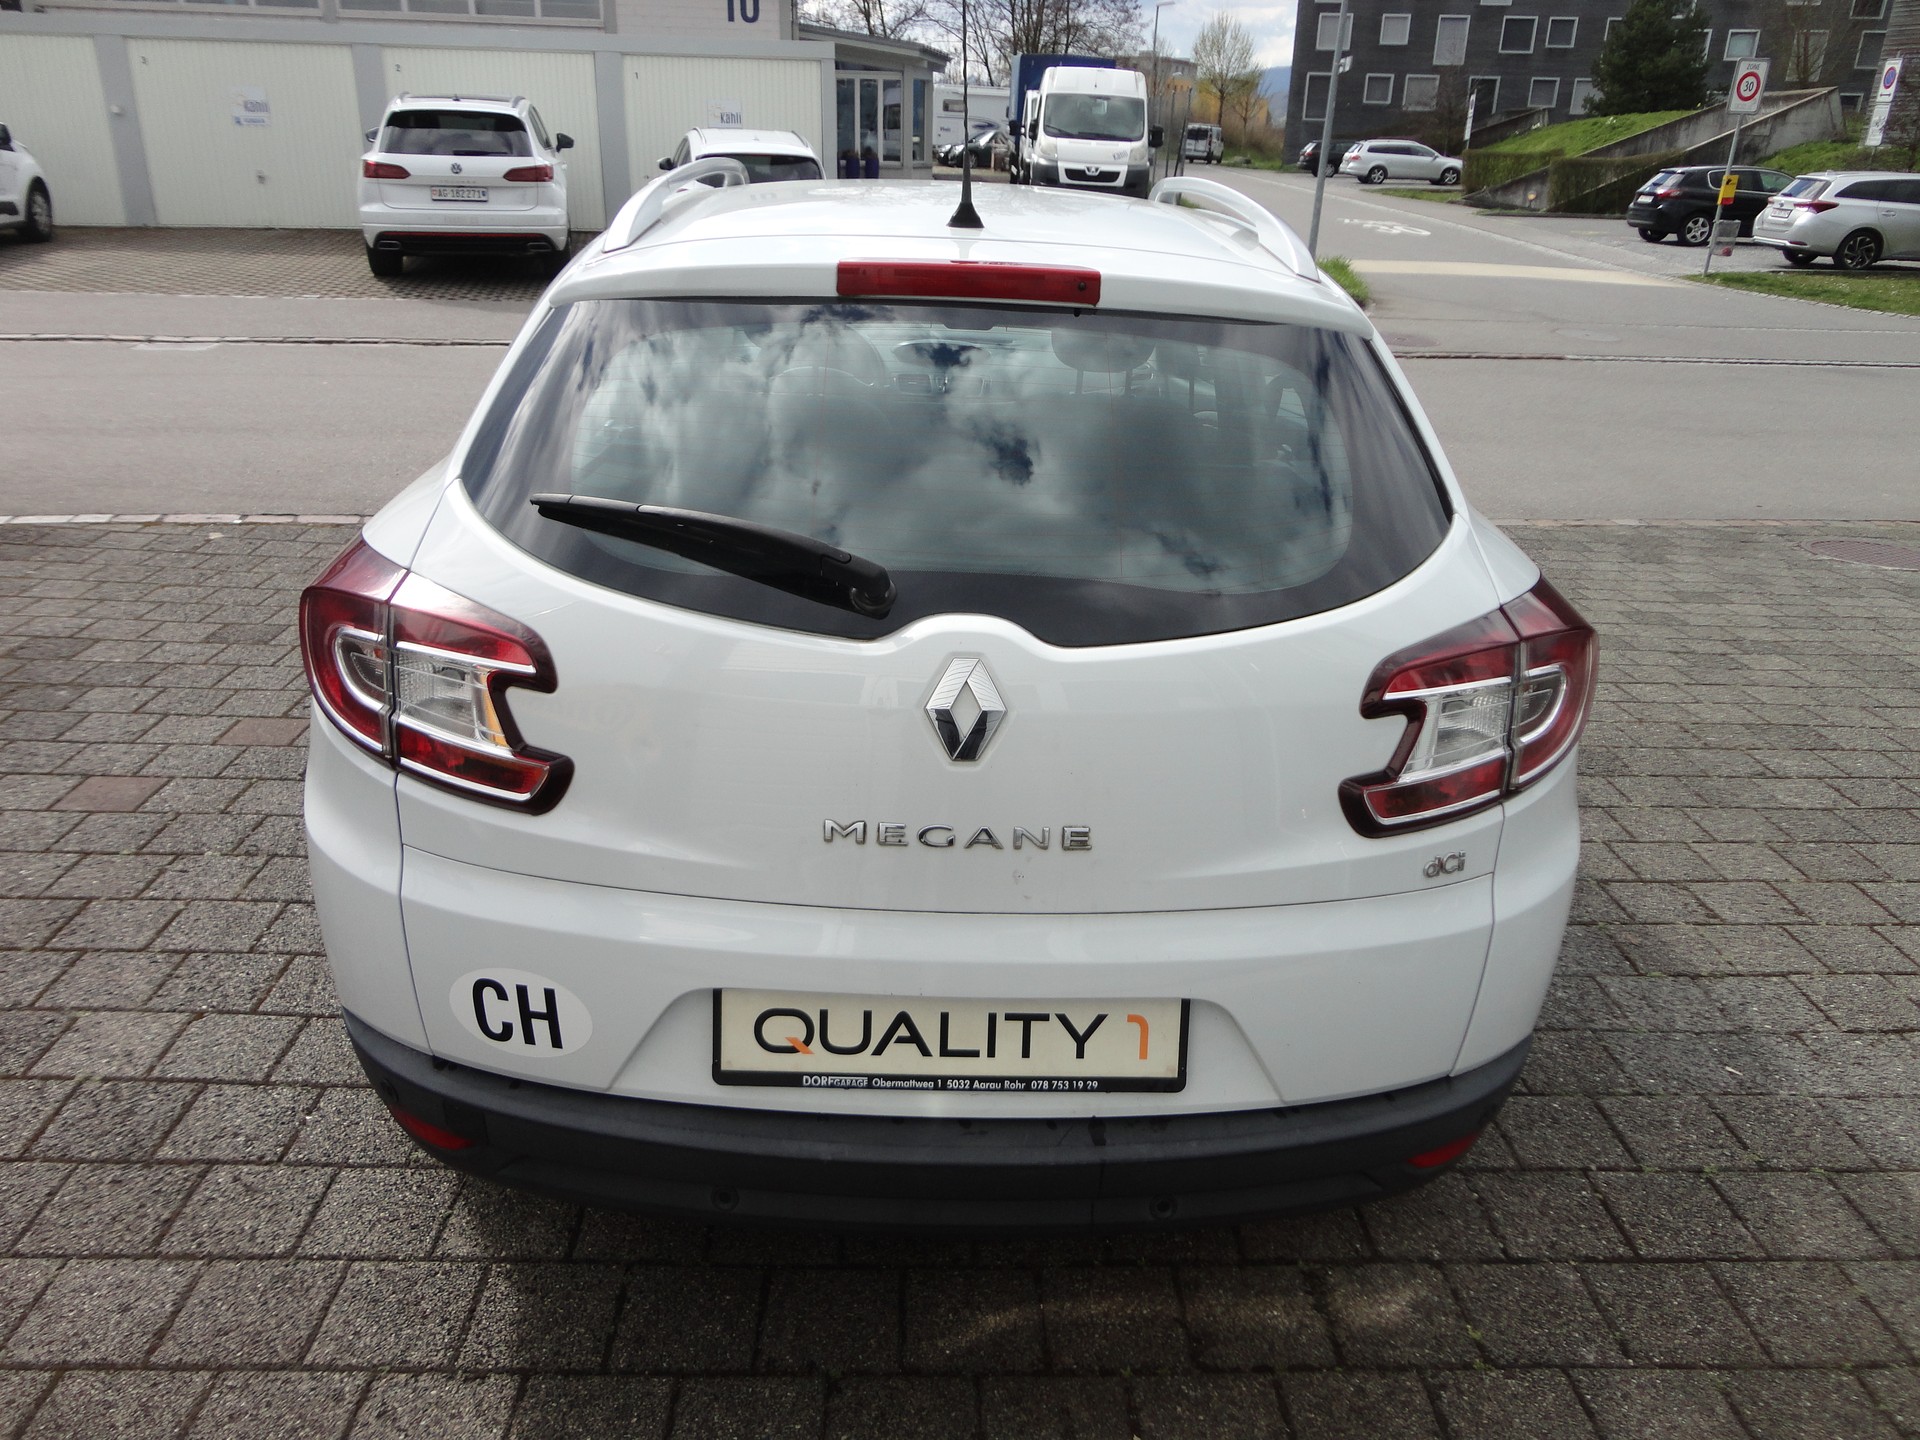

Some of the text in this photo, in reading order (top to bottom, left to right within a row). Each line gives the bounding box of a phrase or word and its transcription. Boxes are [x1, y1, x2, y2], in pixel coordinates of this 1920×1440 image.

[1743, 81, 1754, 92] 30
[823, 818, 1093, 851] MEGANE
[1423, 850, 1466, 878] dCi
[472, 977, 564, 1050] CH
[753, 1007, 1149, 1060] QUALITY 1
[872, 1077, 934, 1090] Obermattweg
[937, 1079, 942, 1088] 1
[946, 1079, 970, 1089] 5032
[972, 1080, 1001, 1090] Aarau
[1004, 1080, 1026, 1090] Rohr
[1031, 1080, 1049, 1090] 078
[1051, 1080, 1069, 1090] 753
[1072, 1080, 1084, 1090] 19
[1086, 1080, 1099, 1090] 29
